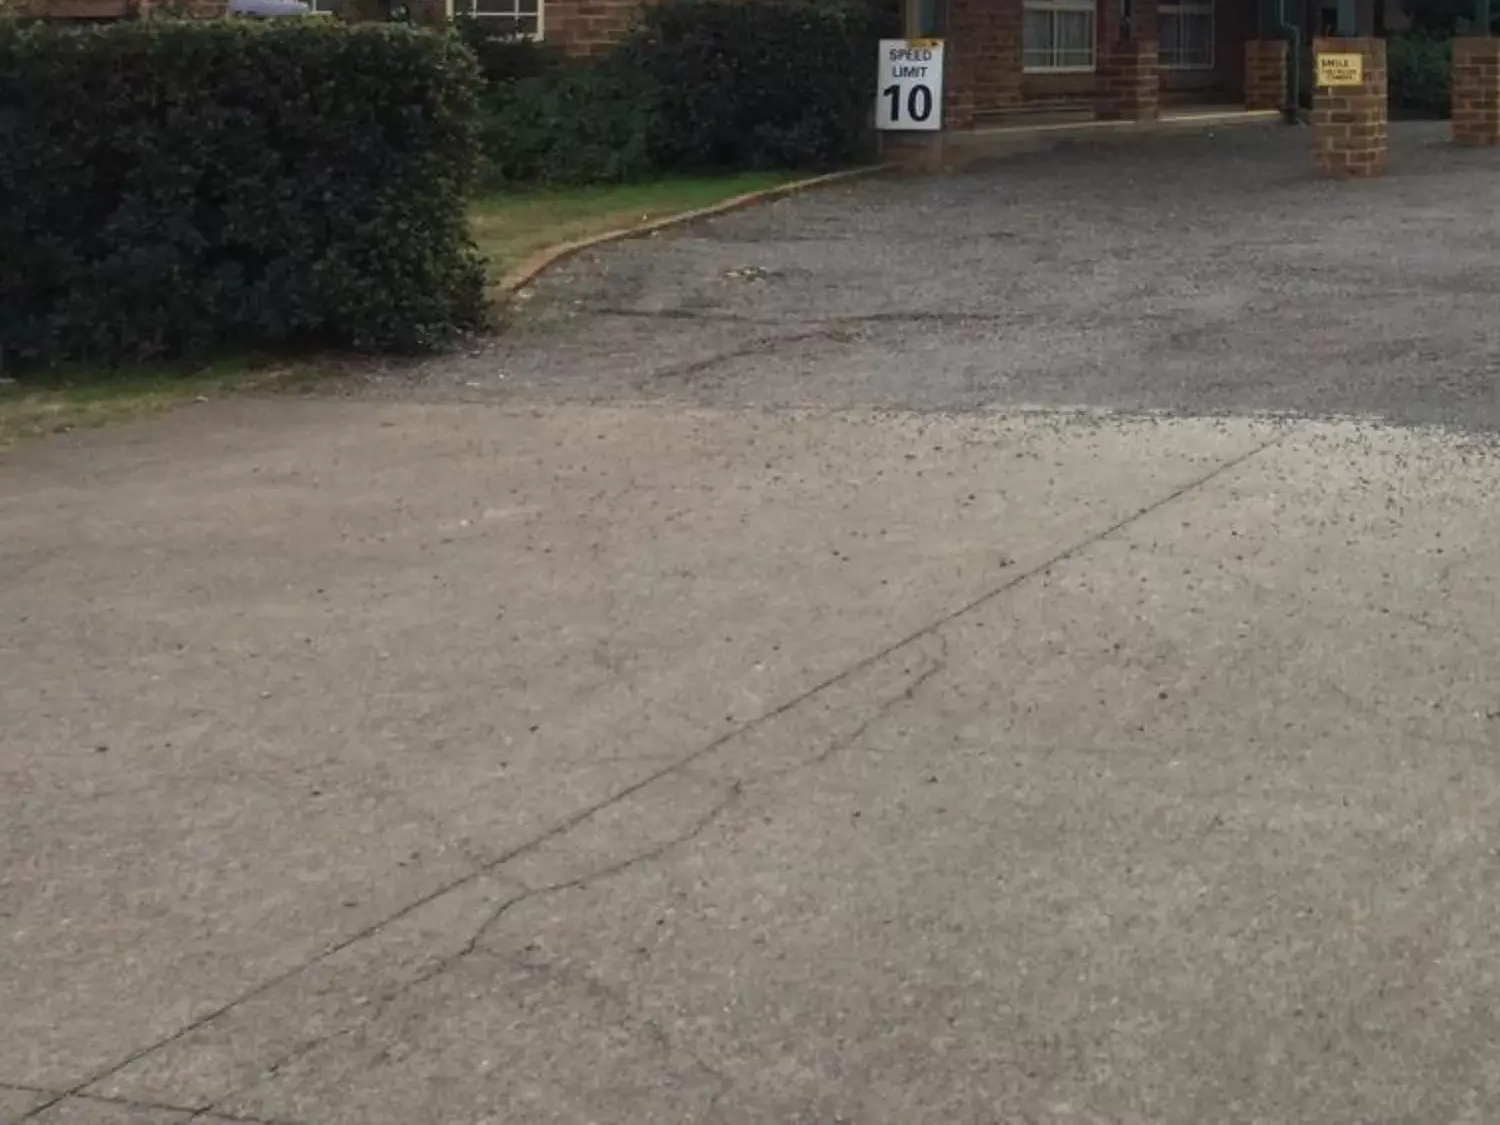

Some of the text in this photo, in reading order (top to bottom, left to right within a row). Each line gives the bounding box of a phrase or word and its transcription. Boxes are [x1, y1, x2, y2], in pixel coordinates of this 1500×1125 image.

[889, 49, 932, 62] SPEED
[892, 66, 928, 78] LIMIT
[883, 84, 933, 122] 10
